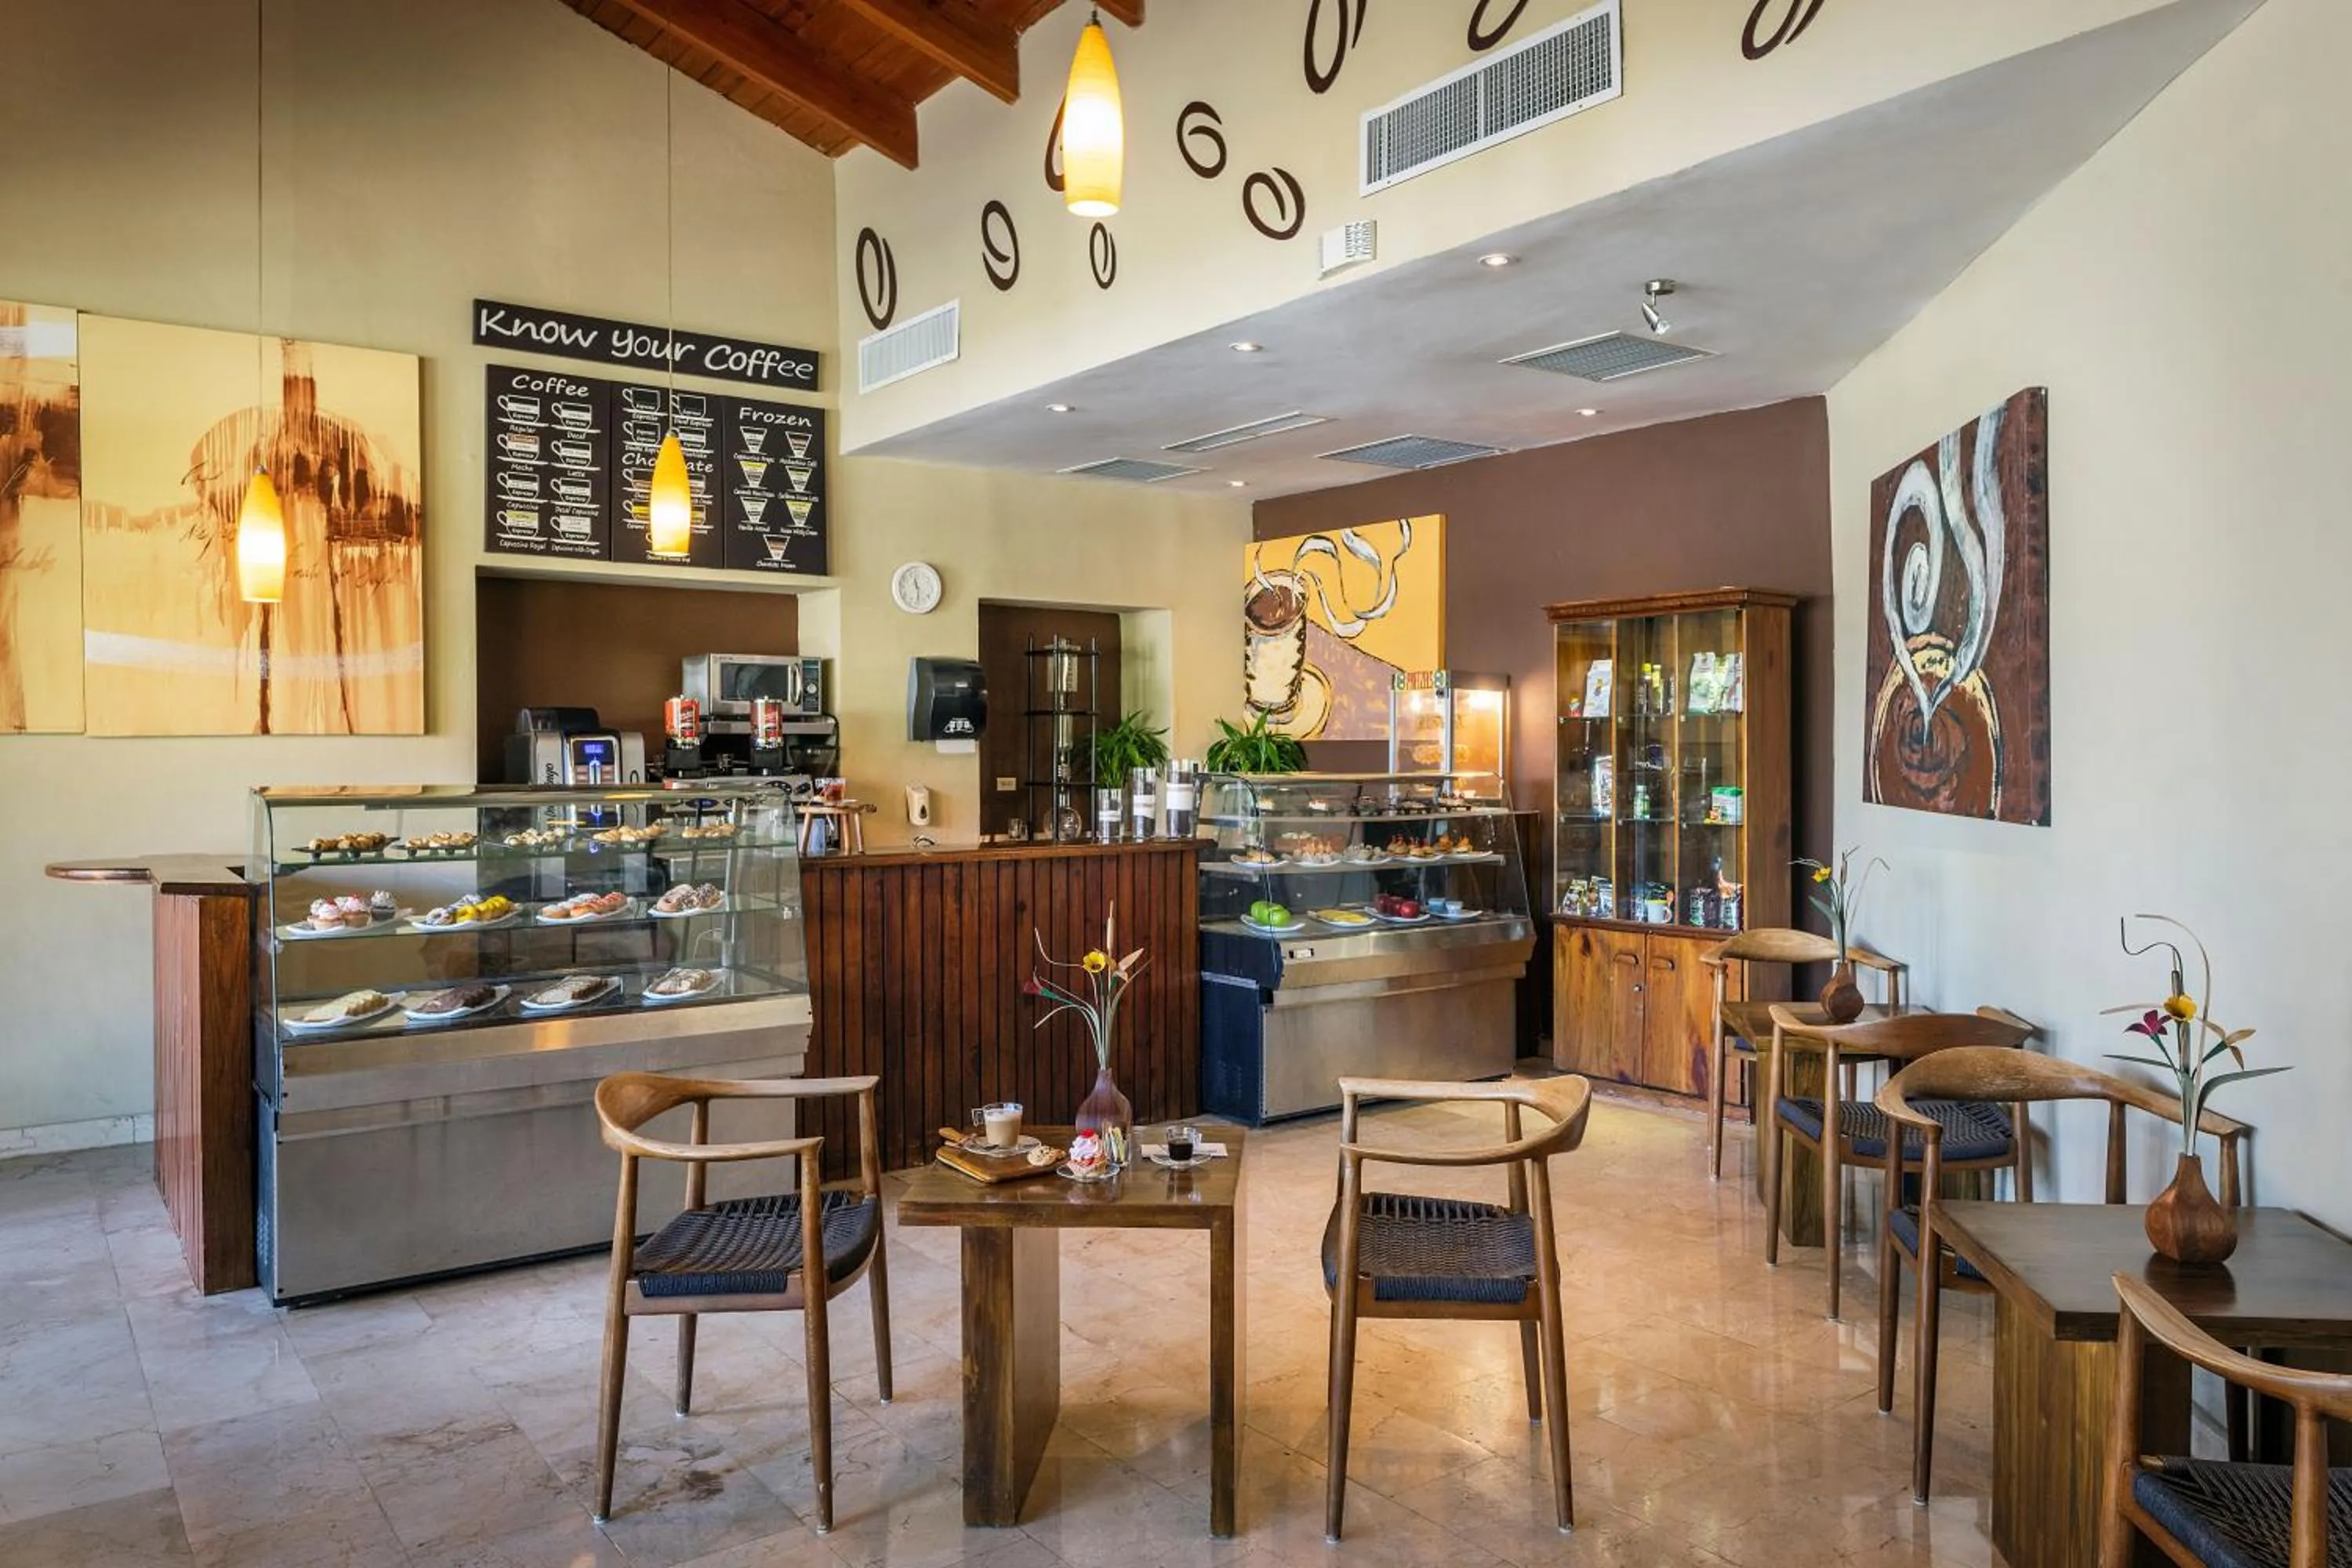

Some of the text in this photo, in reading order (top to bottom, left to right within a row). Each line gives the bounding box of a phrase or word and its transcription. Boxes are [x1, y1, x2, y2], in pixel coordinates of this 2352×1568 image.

[480, 308, 815, 380] Know your Coffee
[512, 374, 590, 397] Coffee
[739, 407, 812, 427] Frozen
[622, 452, 714, 473] Choate
